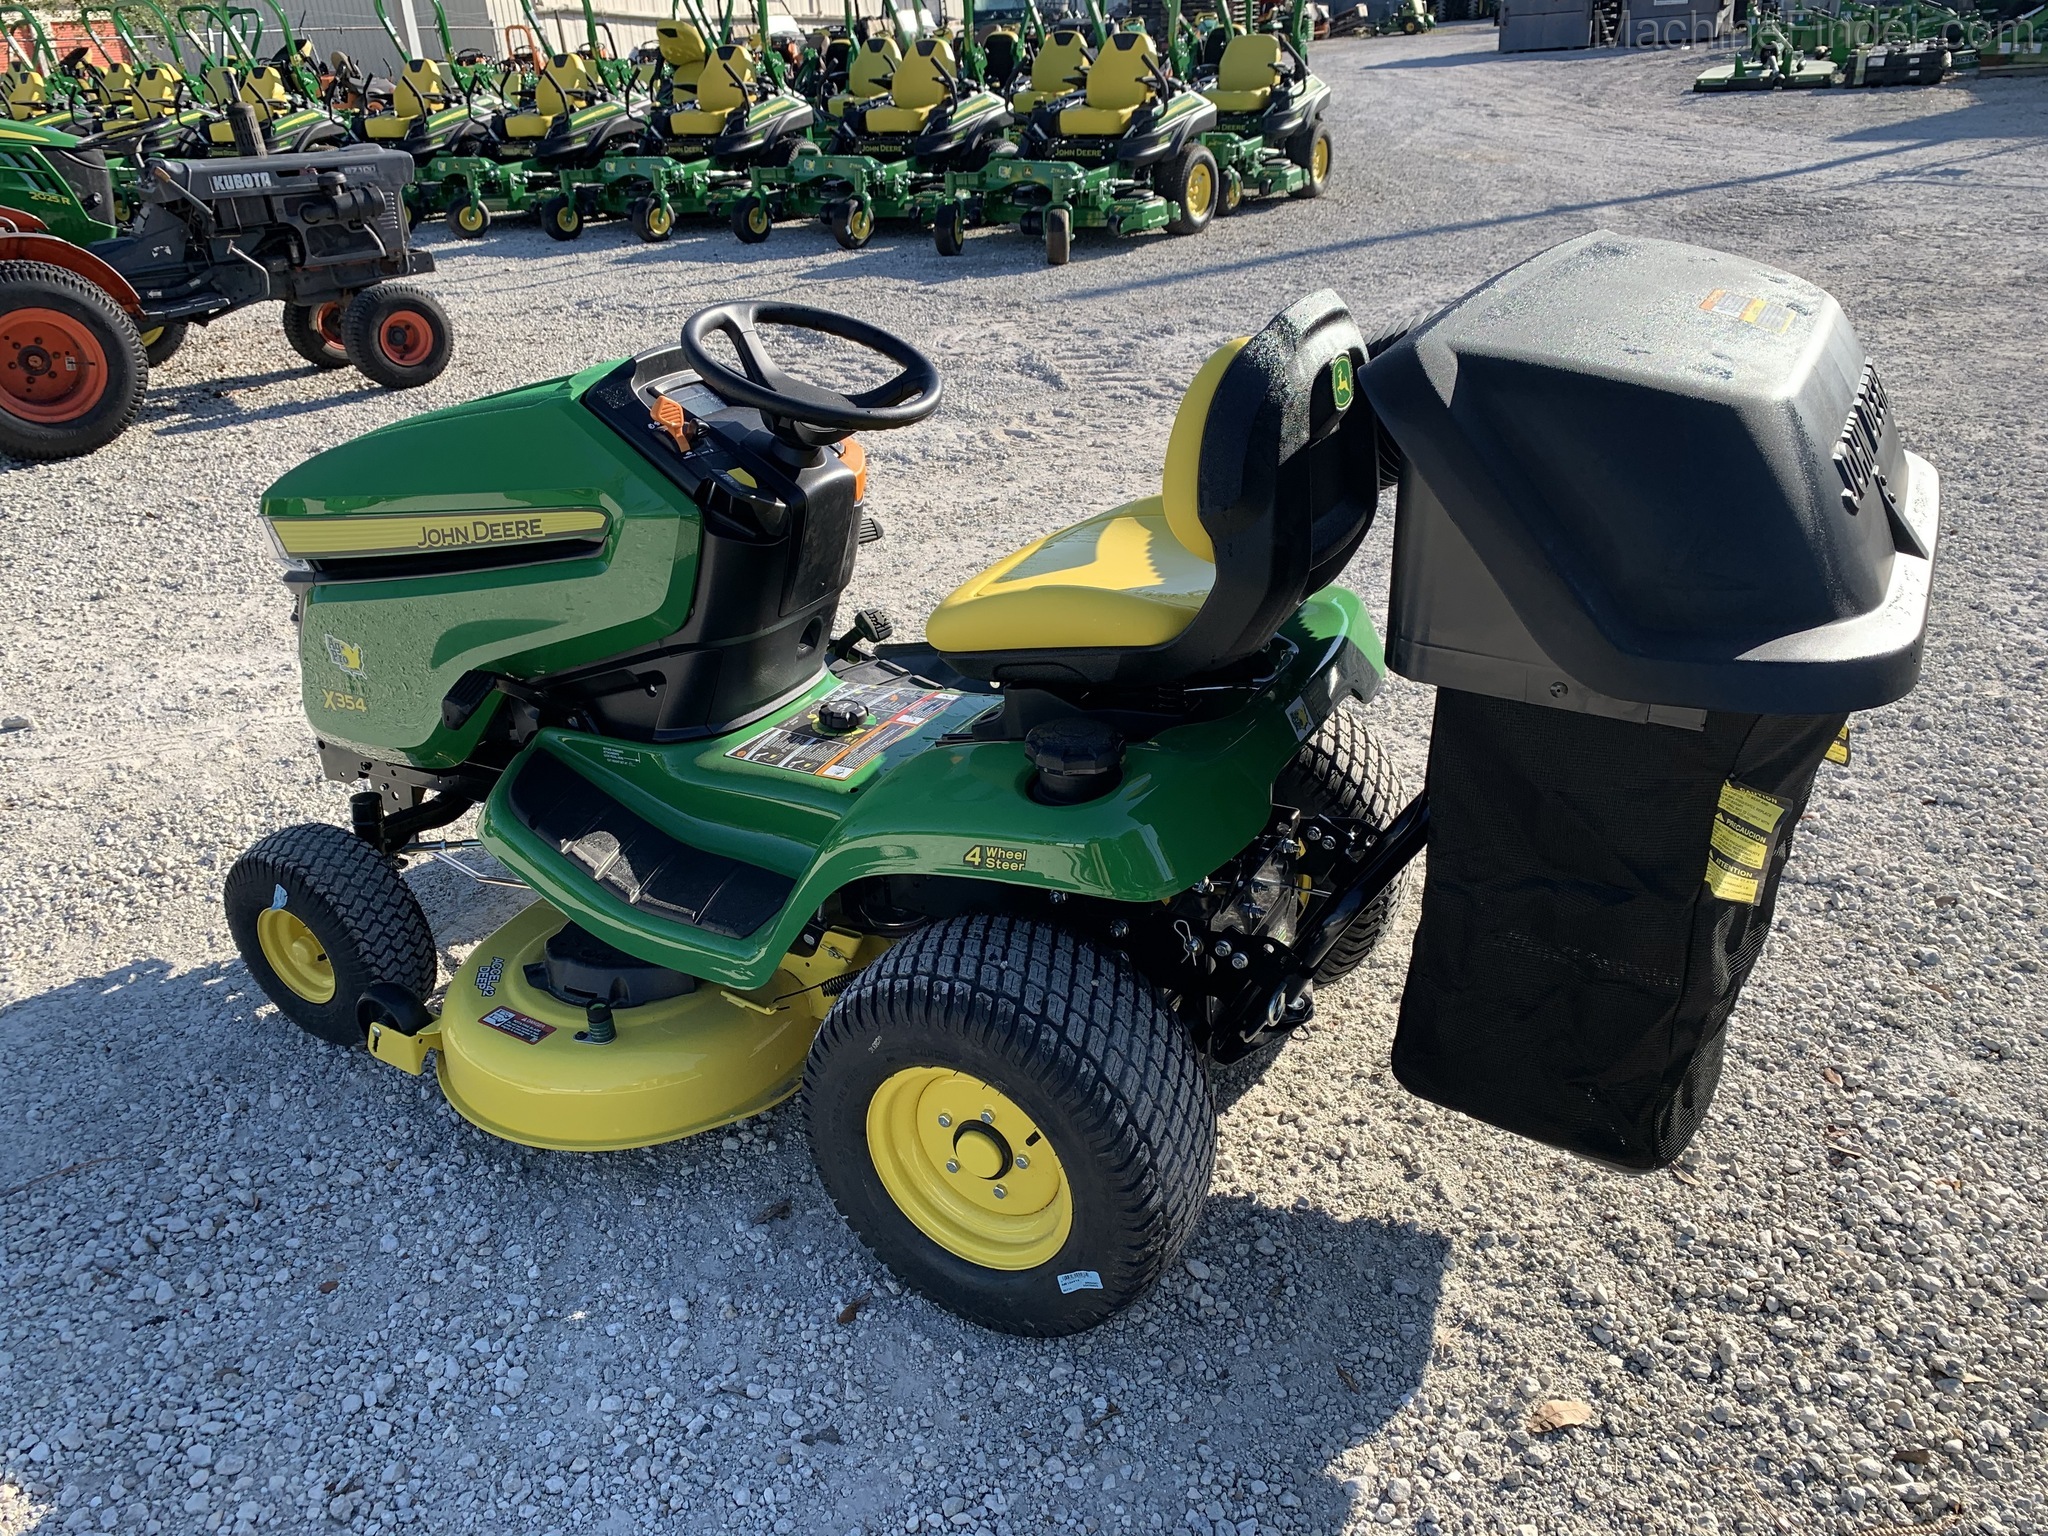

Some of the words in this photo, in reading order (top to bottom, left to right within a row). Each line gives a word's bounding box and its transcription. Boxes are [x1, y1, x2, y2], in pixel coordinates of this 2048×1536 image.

[862, 144, 879, 152] JOHN
[880, 144, 902, 152] DEERE
[1055, 148, 1075, 156] JOHN
[1076, 148, 1102, 157] DEERE
[212, 171, 271, 191] KUBOTA
[417, 526, 470, 546] JOHN
[473, 518, 543, 541] DEERE
[321, 687, 368, 712] X354
[1725, 818, 1767, 844] PRECAUCION
[964, 846, 981, 866] 4
[986, 846, 1026, 861] Wheel
[985, 857, 1025, 872] Steer
[1715, 857, 1753, 879] ATTENTION
[475, 966, 491, 990] DEEP
[487, 957, 505, 986] ACCEL
